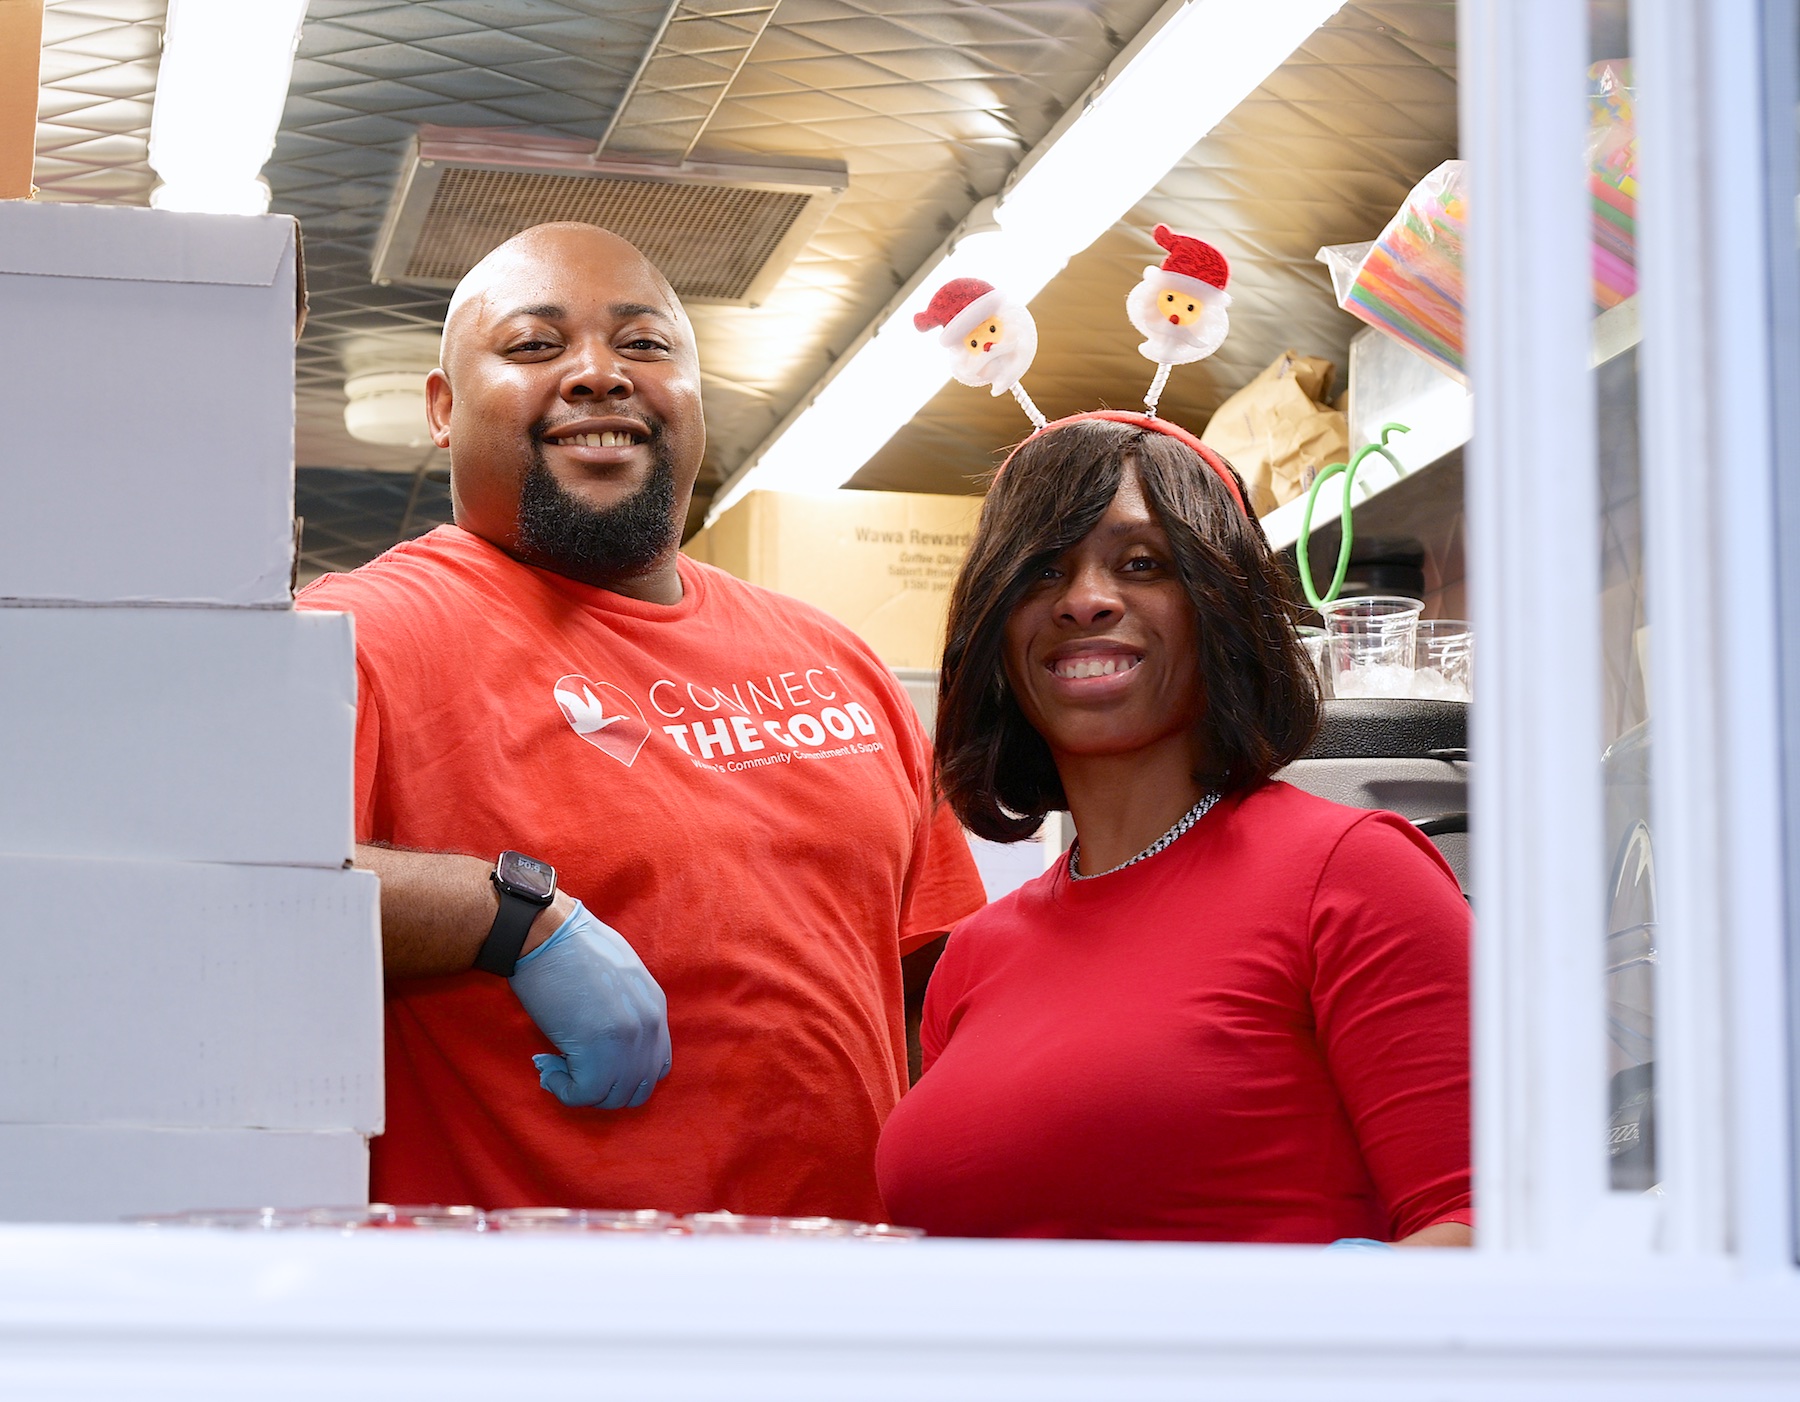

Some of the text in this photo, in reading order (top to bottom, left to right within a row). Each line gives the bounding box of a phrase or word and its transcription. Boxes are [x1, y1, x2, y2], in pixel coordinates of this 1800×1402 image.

[855, 526, 903, 544] Wawa
[650, 666, 853, 719] CONNECT
[662, 702, 877, 759] THE GOOD
[727, 752, 791, 772] Community
[793, 746, 851, 760] Commitment
[850, 744, 859, 754] &
